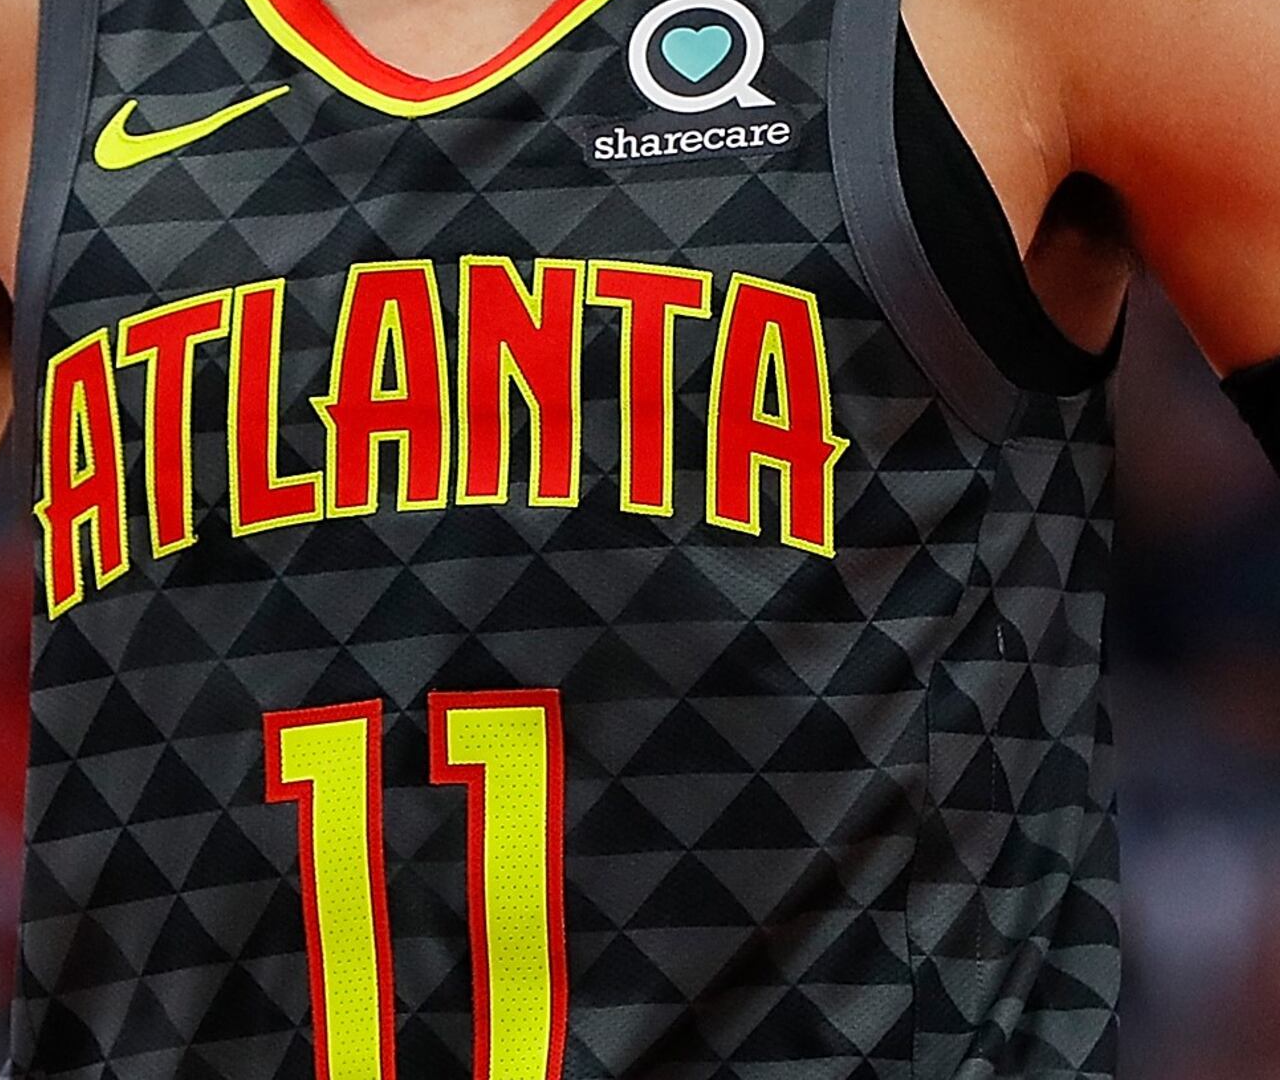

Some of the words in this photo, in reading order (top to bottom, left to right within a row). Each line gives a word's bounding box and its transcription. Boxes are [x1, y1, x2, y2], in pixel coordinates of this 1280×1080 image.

[594, 121, 791, 160] sharecare
[34, 254, 851, 621] ATLANTA
[262, 688, 569, 1080] 11
